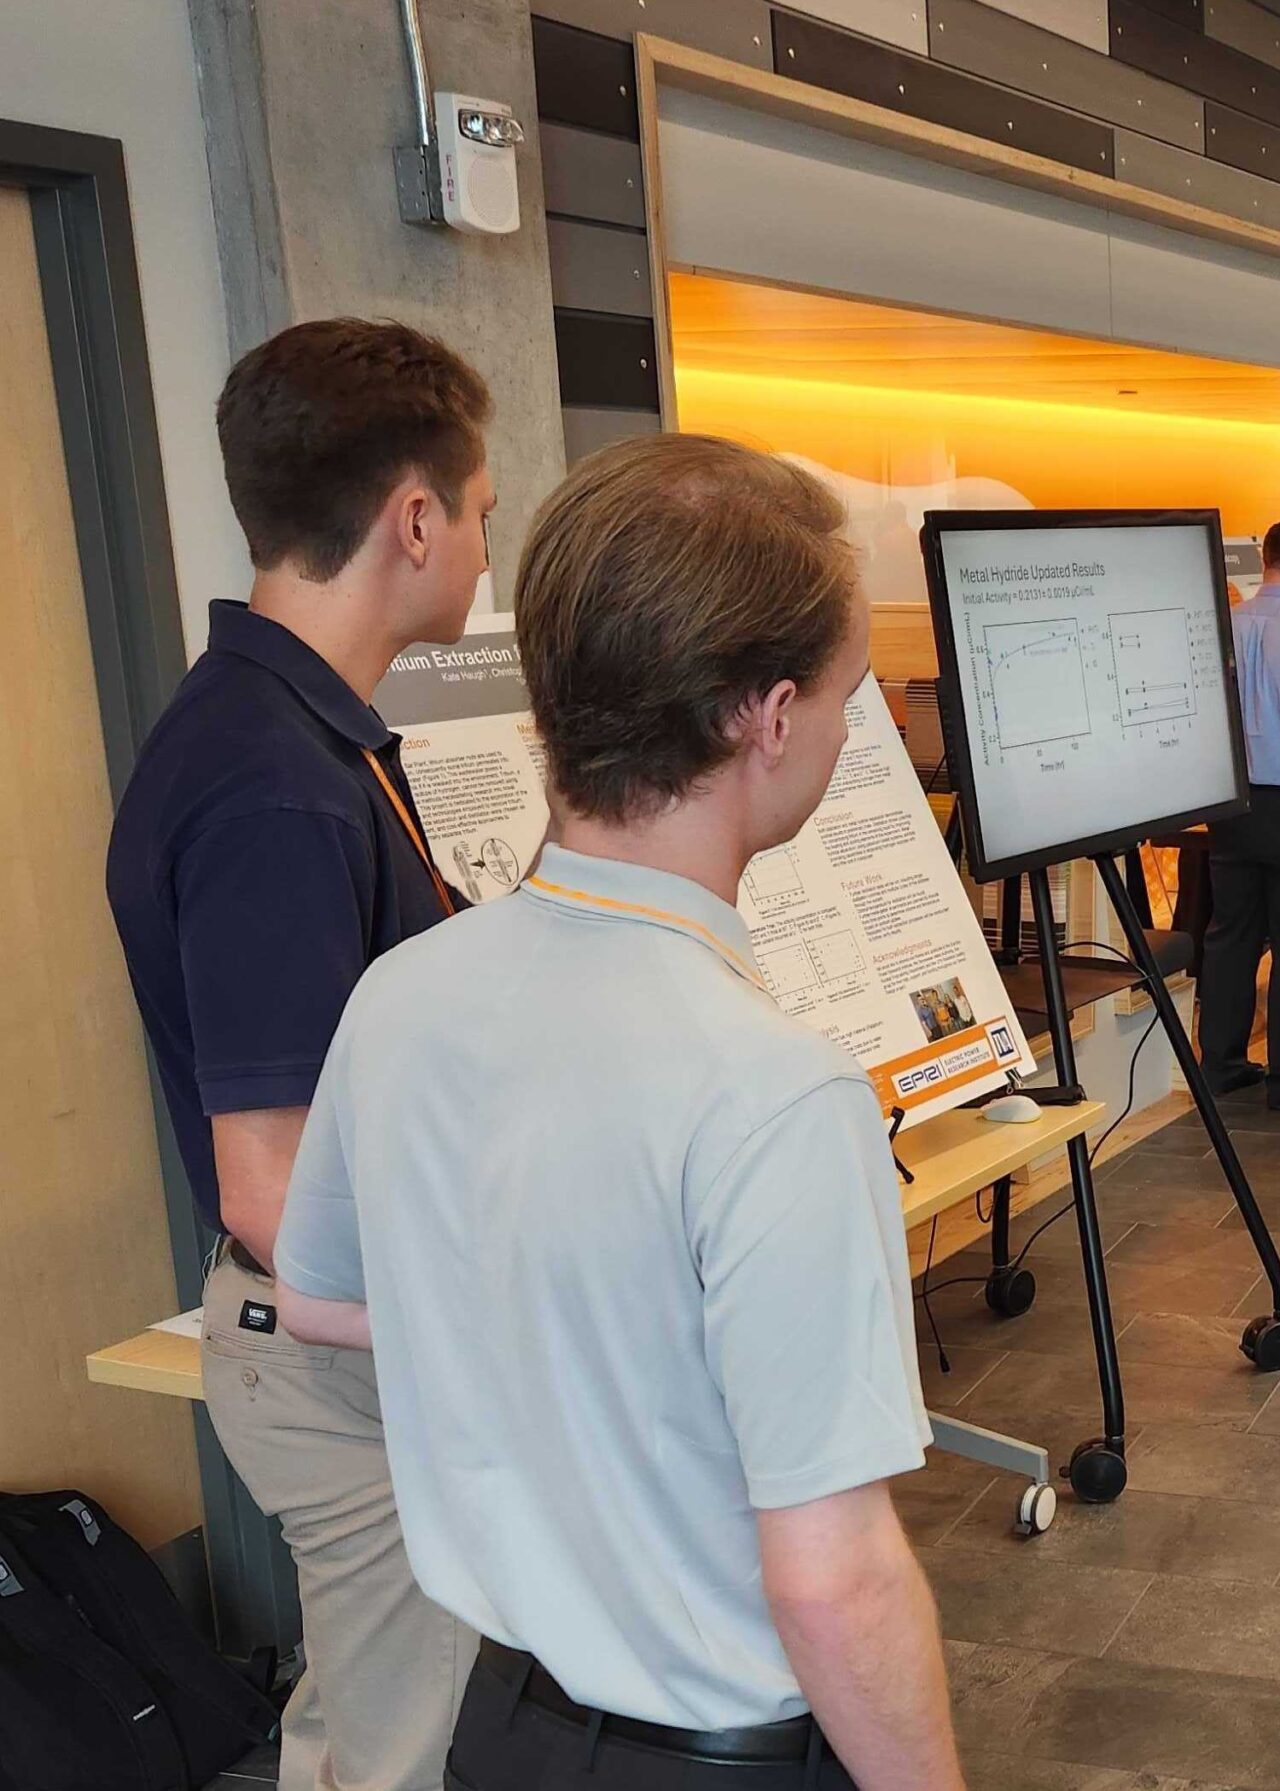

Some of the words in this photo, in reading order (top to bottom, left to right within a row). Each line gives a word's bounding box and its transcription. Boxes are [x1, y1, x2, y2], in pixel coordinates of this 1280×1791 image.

[446, 154, 454, 202] FIRE
[960, 567, 990, 583] Metal
[991, 563, 1030, 585] Hydride
[1030, 561, 1071, 582] Updated
[1071, 559, 1106, 577] Results
[962, 592, 984, 605] Initial
[985, 590, 1012, 605] Activity
[387, 654, 431, 672] itium
[431, 645, 513, 669] Extraction
[402, 738, 430, 750] ction
[898, 1064, 943, 1093] EPRI
